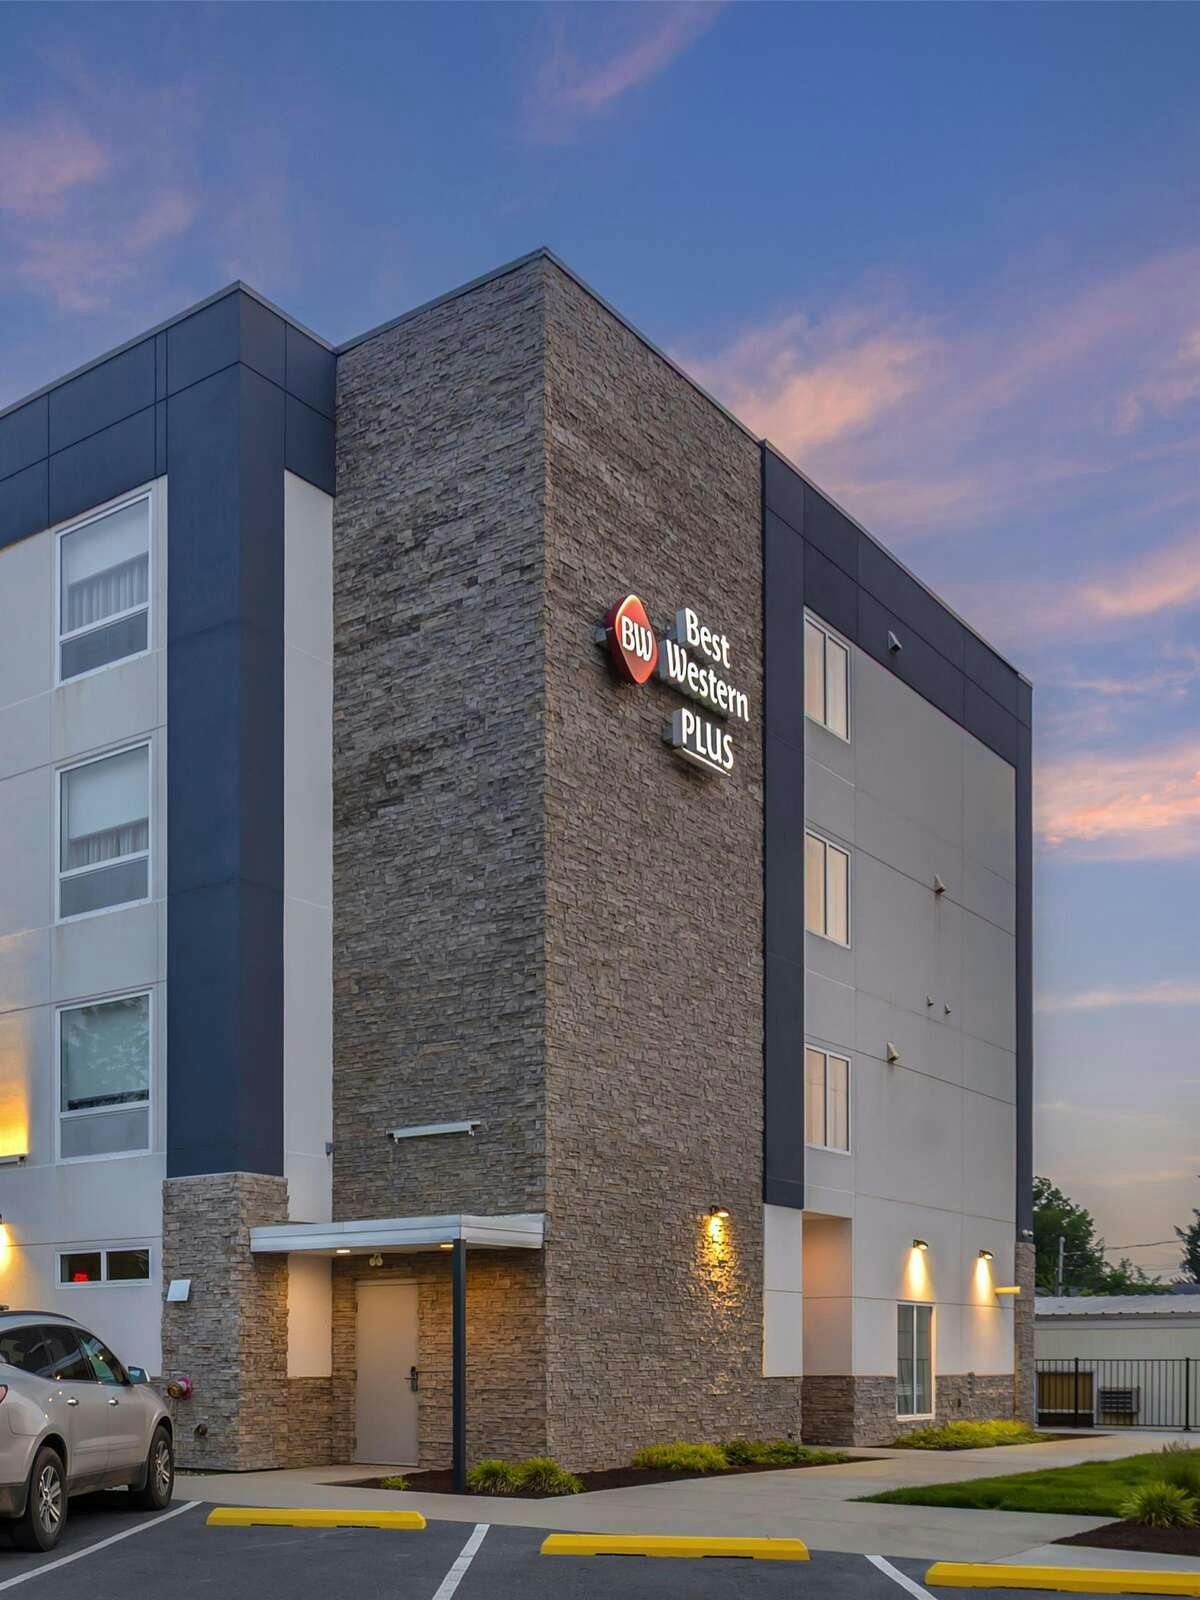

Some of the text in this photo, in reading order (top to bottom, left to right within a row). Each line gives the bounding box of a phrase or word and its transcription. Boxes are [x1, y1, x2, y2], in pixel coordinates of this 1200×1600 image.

[621, 615, 653, 662] BW
[684, 607, 731, 669] Best
[666, 639, 750, 722] Western
[681, 707, 734, 770] PLUS
